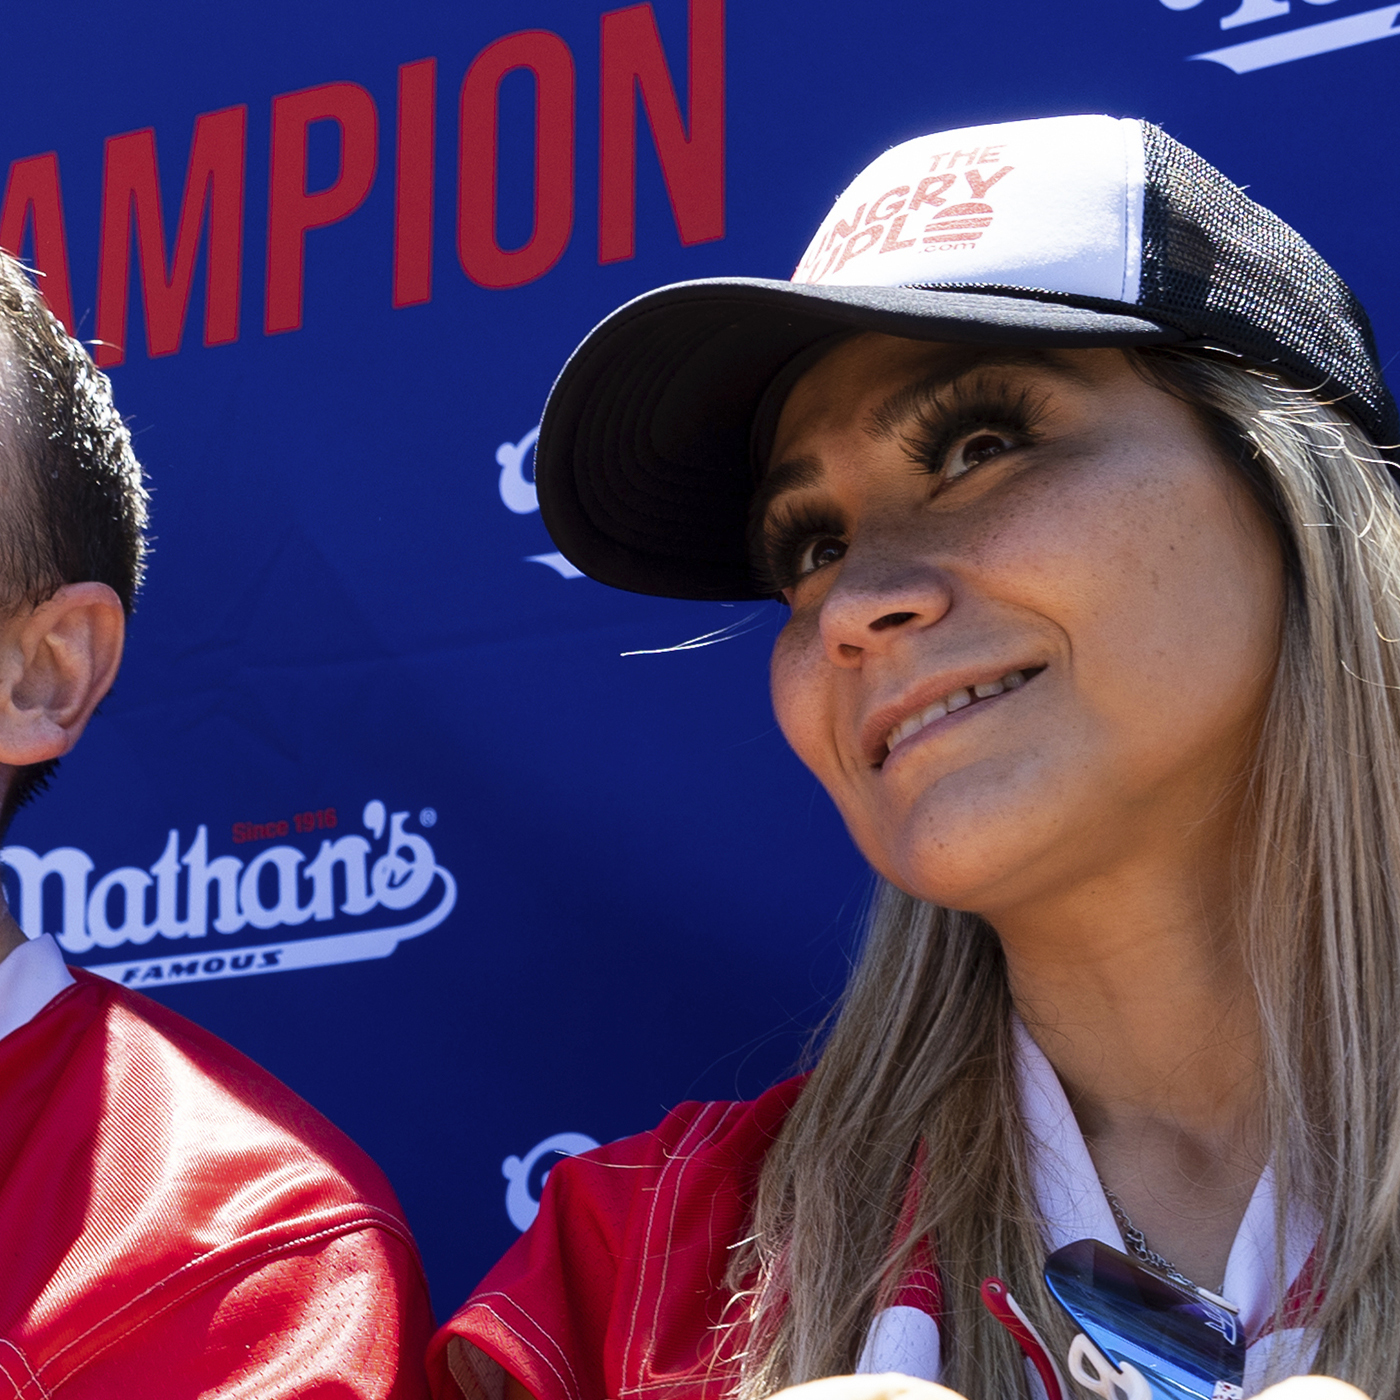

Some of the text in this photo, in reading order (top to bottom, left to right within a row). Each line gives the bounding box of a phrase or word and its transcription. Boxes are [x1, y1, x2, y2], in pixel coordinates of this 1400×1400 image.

[929, 145, 1007, 173] THE
[232, 807, 338, 845] Since 1916
[120, 948, 286, 986] FAMOUS
